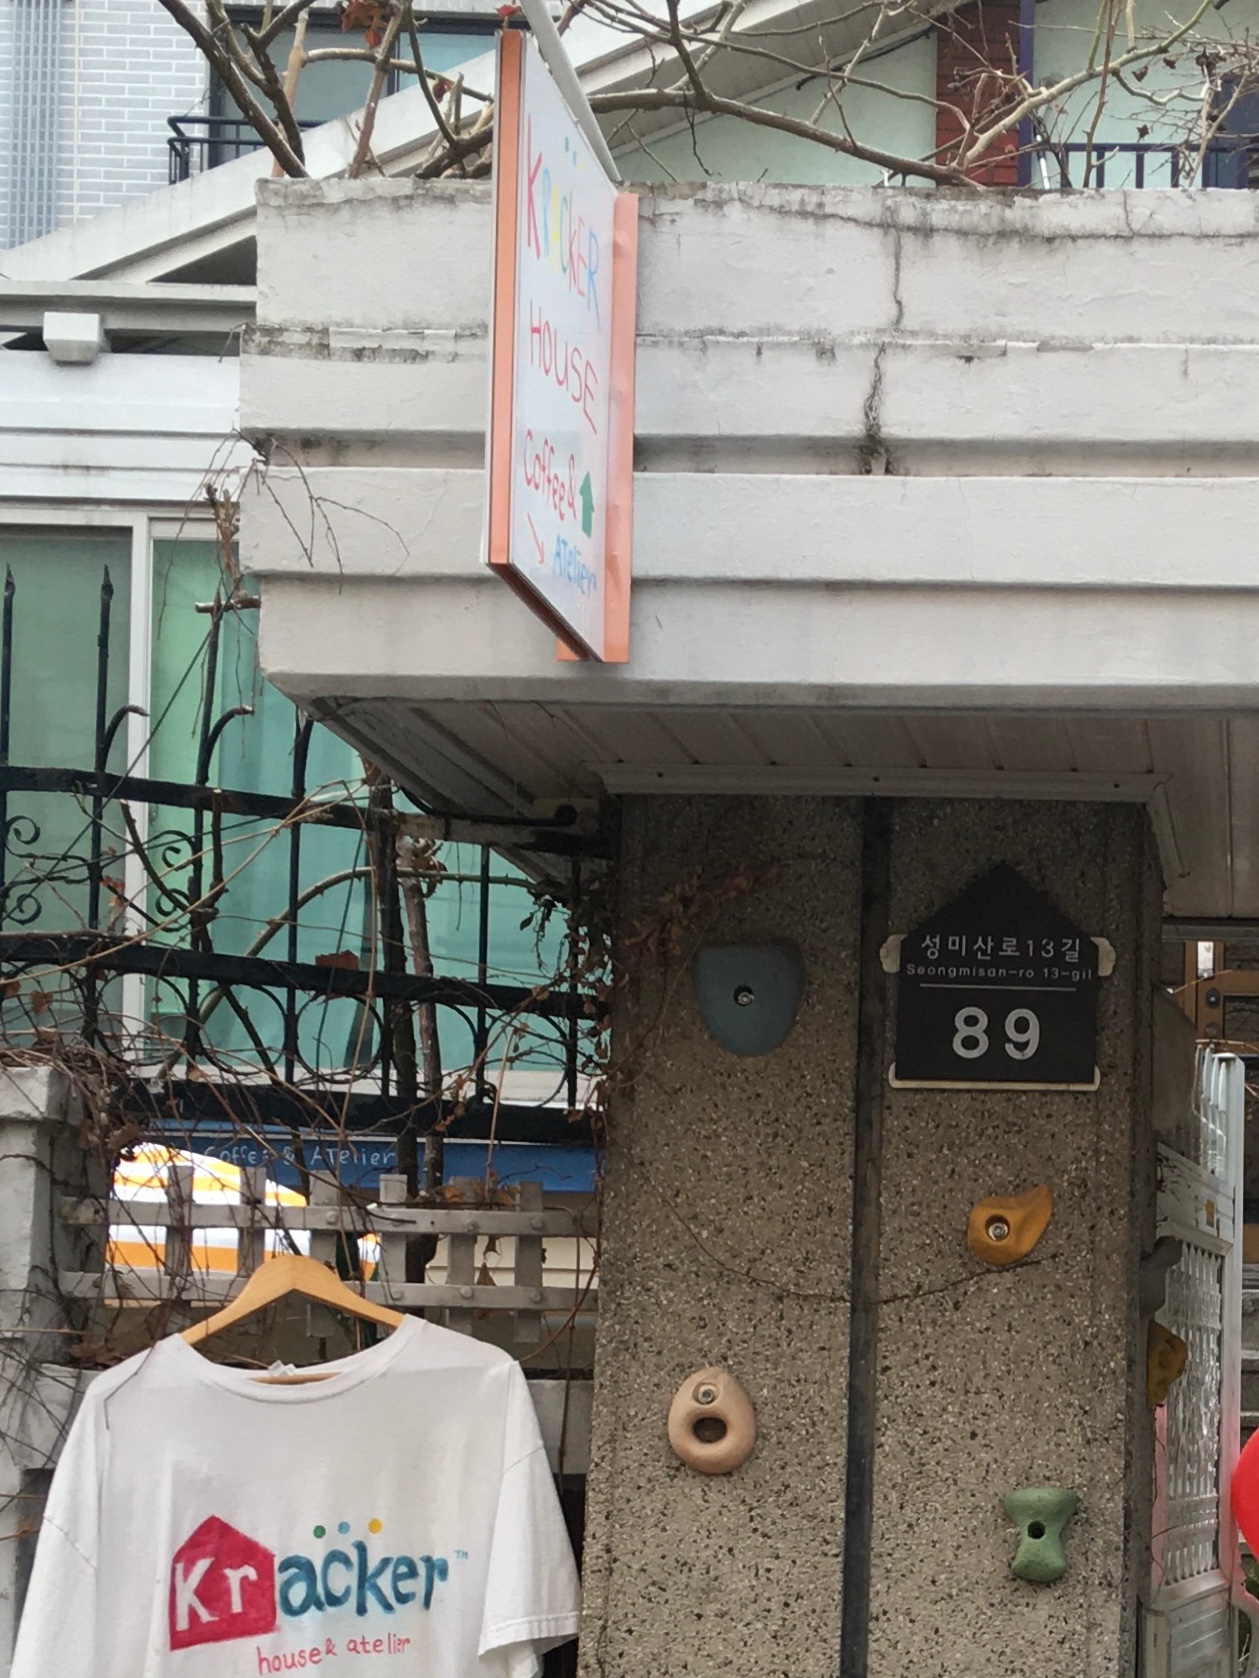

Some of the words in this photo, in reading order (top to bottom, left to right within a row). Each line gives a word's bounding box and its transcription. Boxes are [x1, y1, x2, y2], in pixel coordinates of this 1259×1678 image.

[529, 299, 598, 434] HOUSE
[920, 934, 1080, 963] 성미산로13길
[906, 963, 1035, 979] Seongmisan-ro
[1042, 967, 1092, 982] 13-gil
[952, 1006, 1041, 1060] 89
[172, 1539, 450, 1632] Kracker
[256, 1644, 322, 1676] house
[325, 1637, 336, 1657] &
